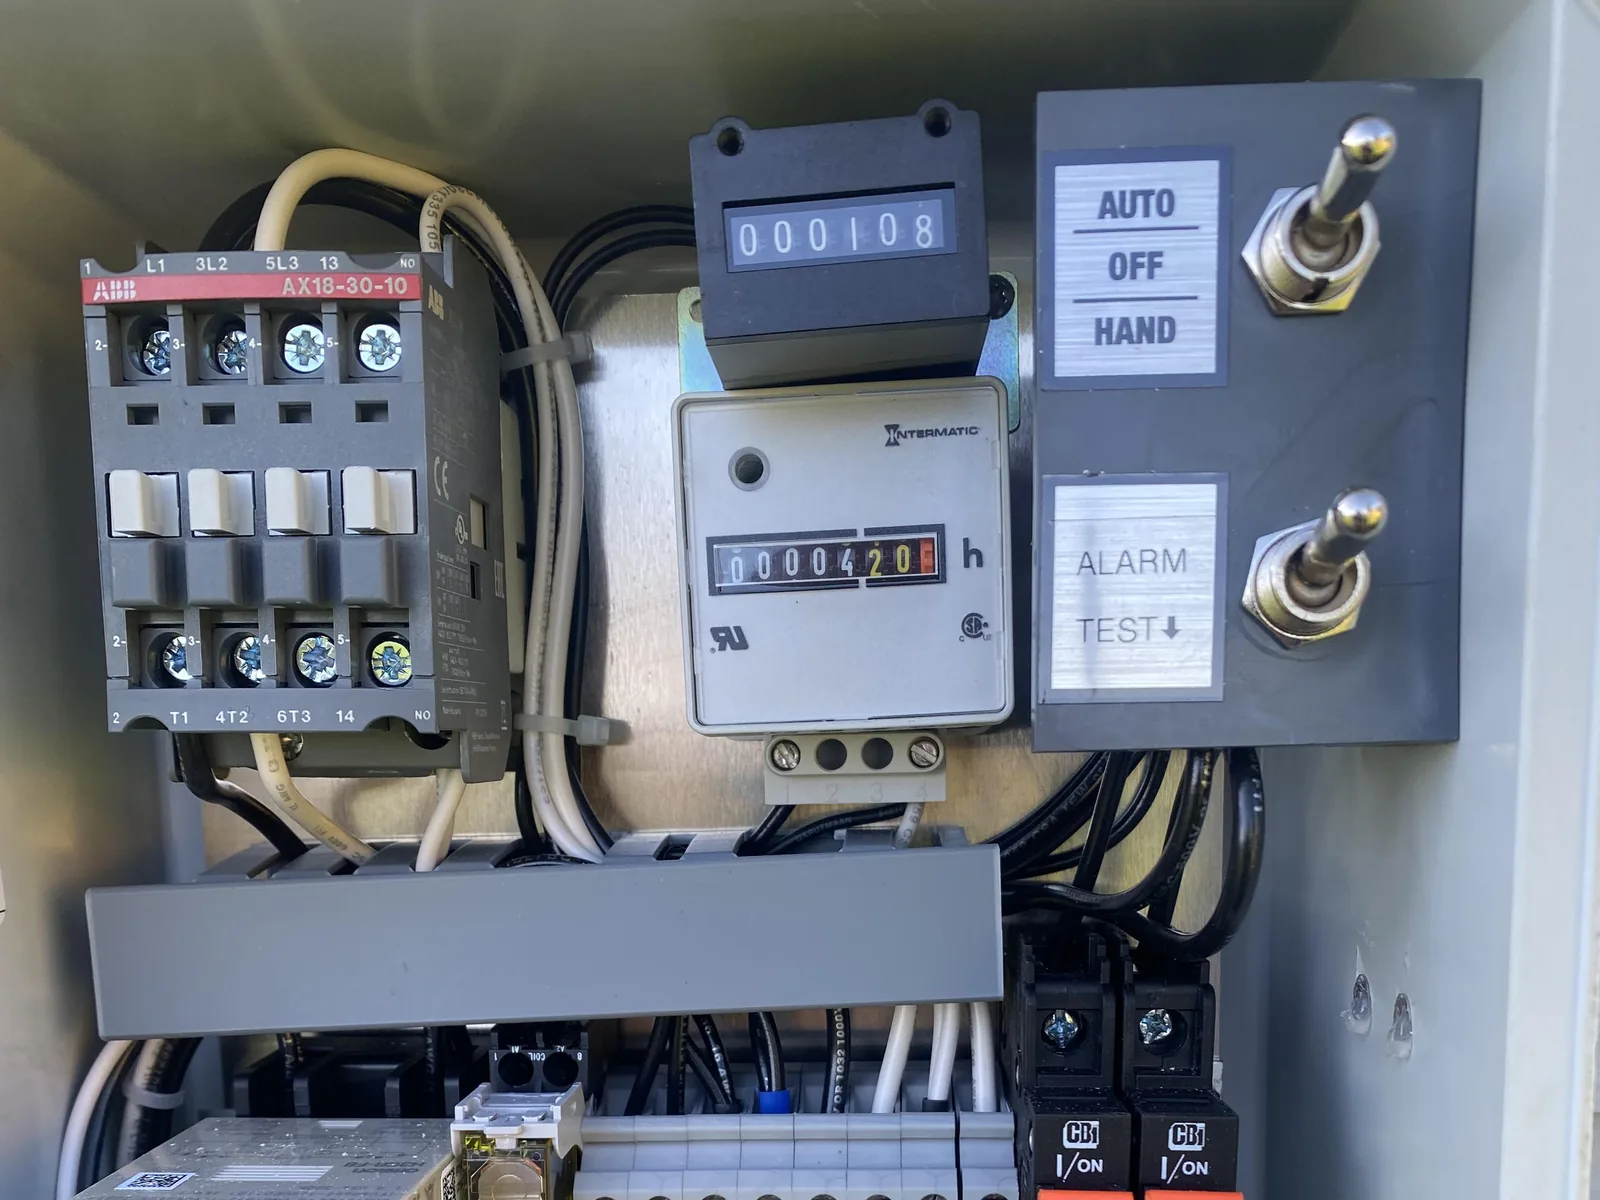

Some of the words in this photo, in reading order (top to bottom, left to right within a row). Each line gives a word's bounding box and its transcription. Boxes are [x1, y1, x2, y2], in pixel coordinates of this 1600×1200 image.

[1097, 188, 1175, 220] AUTO
[739, 212, 933, 257] 000108
[84, 262, 91, 274] 1
[146, 258, 165, 273] L1
[196, 257, 228, 271] 3L2
[265, 256, 299, 270] 5L3
[319, 256, 339, 270] 13
[400, 258, 415, 268] NO
[1108, 251, 1164, 281] OFF
[93, 280, 137, 300] ABB
[282, 277, 408, 295] AX18-30-10
[1094, 315, 1176, 346] HAND
[884, 424, 981, 447] INTERMATIC
[962, 537, 984, 569] h
[1077, 548, 1187, 575] ALARM
[1076, 616, 1158, 643] TEST
[112, 712, 120, 724] 2
[170, 711, 188, 724] T1
[215, 710, 249, 724] 4T2
[277, 710, 311, 723] 6T3
[336, 710, 355, 723] 14
[415, 710, 431, 720] NO
[528, 1052, 546, 1061] COIL
[836, 1049, 846, 1081] 1032
[833, 1085, 843, 1103] OR
